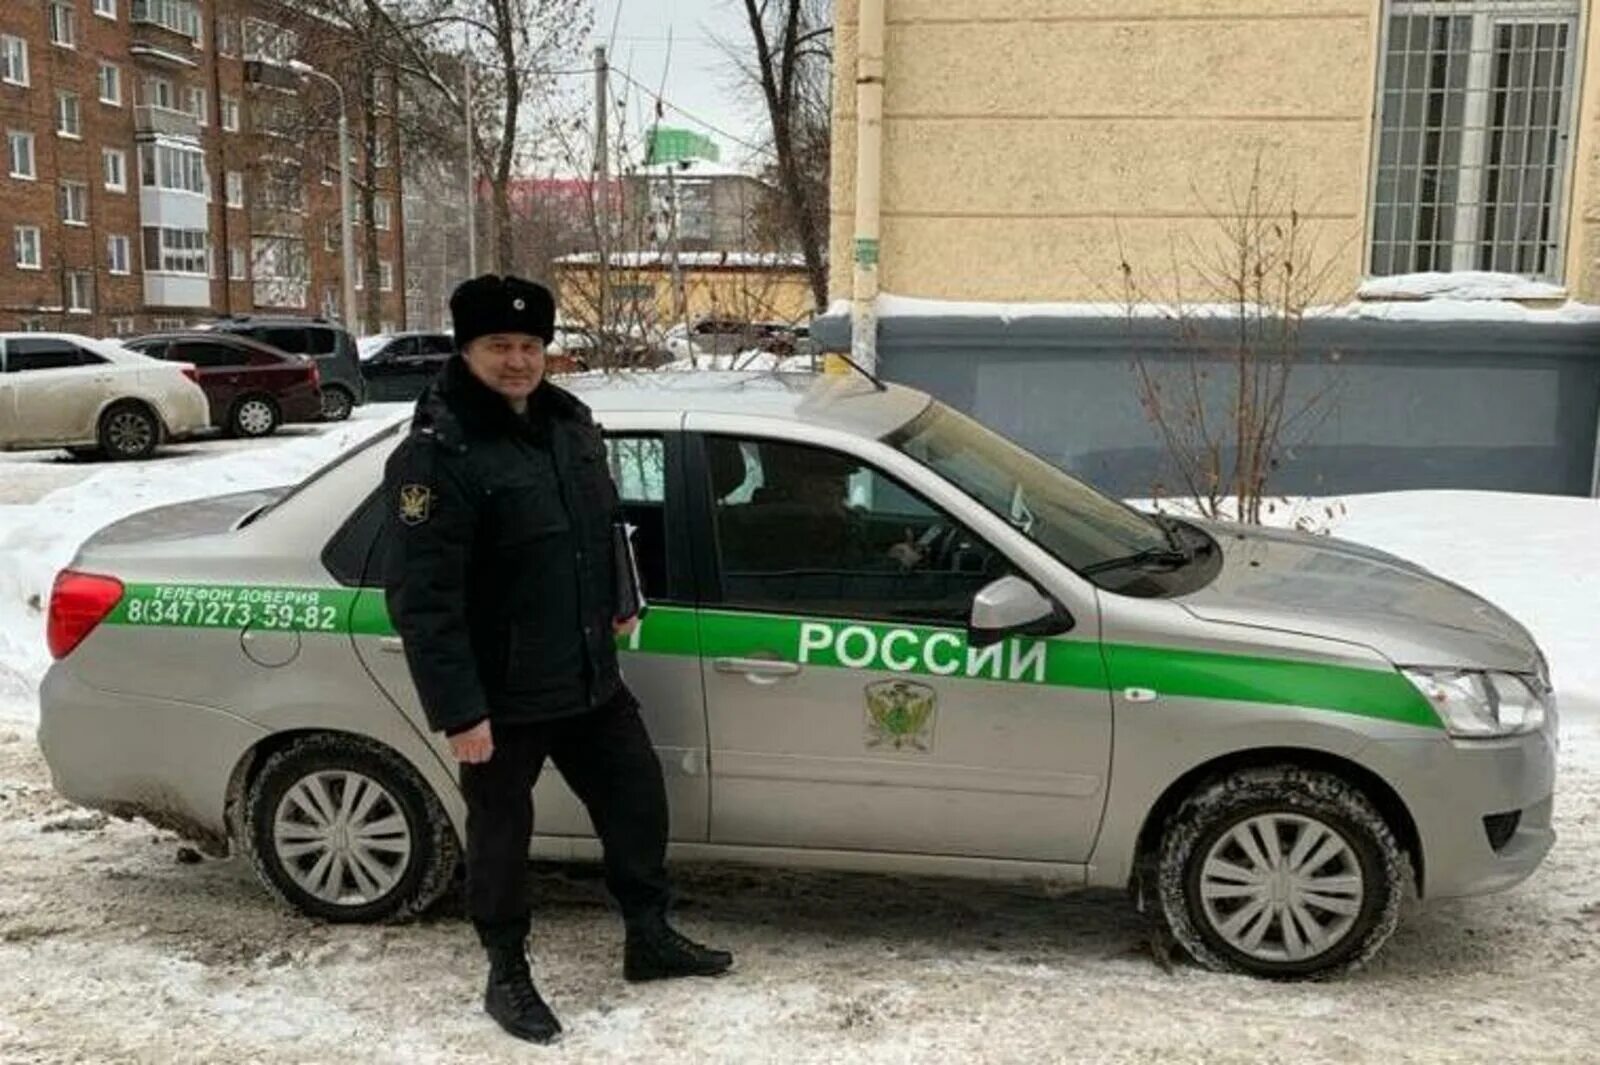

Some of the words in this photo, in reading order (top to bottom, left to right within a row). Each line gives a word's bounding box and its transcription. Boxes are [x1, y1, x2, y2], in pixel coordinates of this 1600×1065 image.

[154, 586, 235, 601] ТЕЛЕФОН
[237, 588, 320, 605] ДОВЕРИЯ
[798, 622, 1047, 682] РОССИИ
